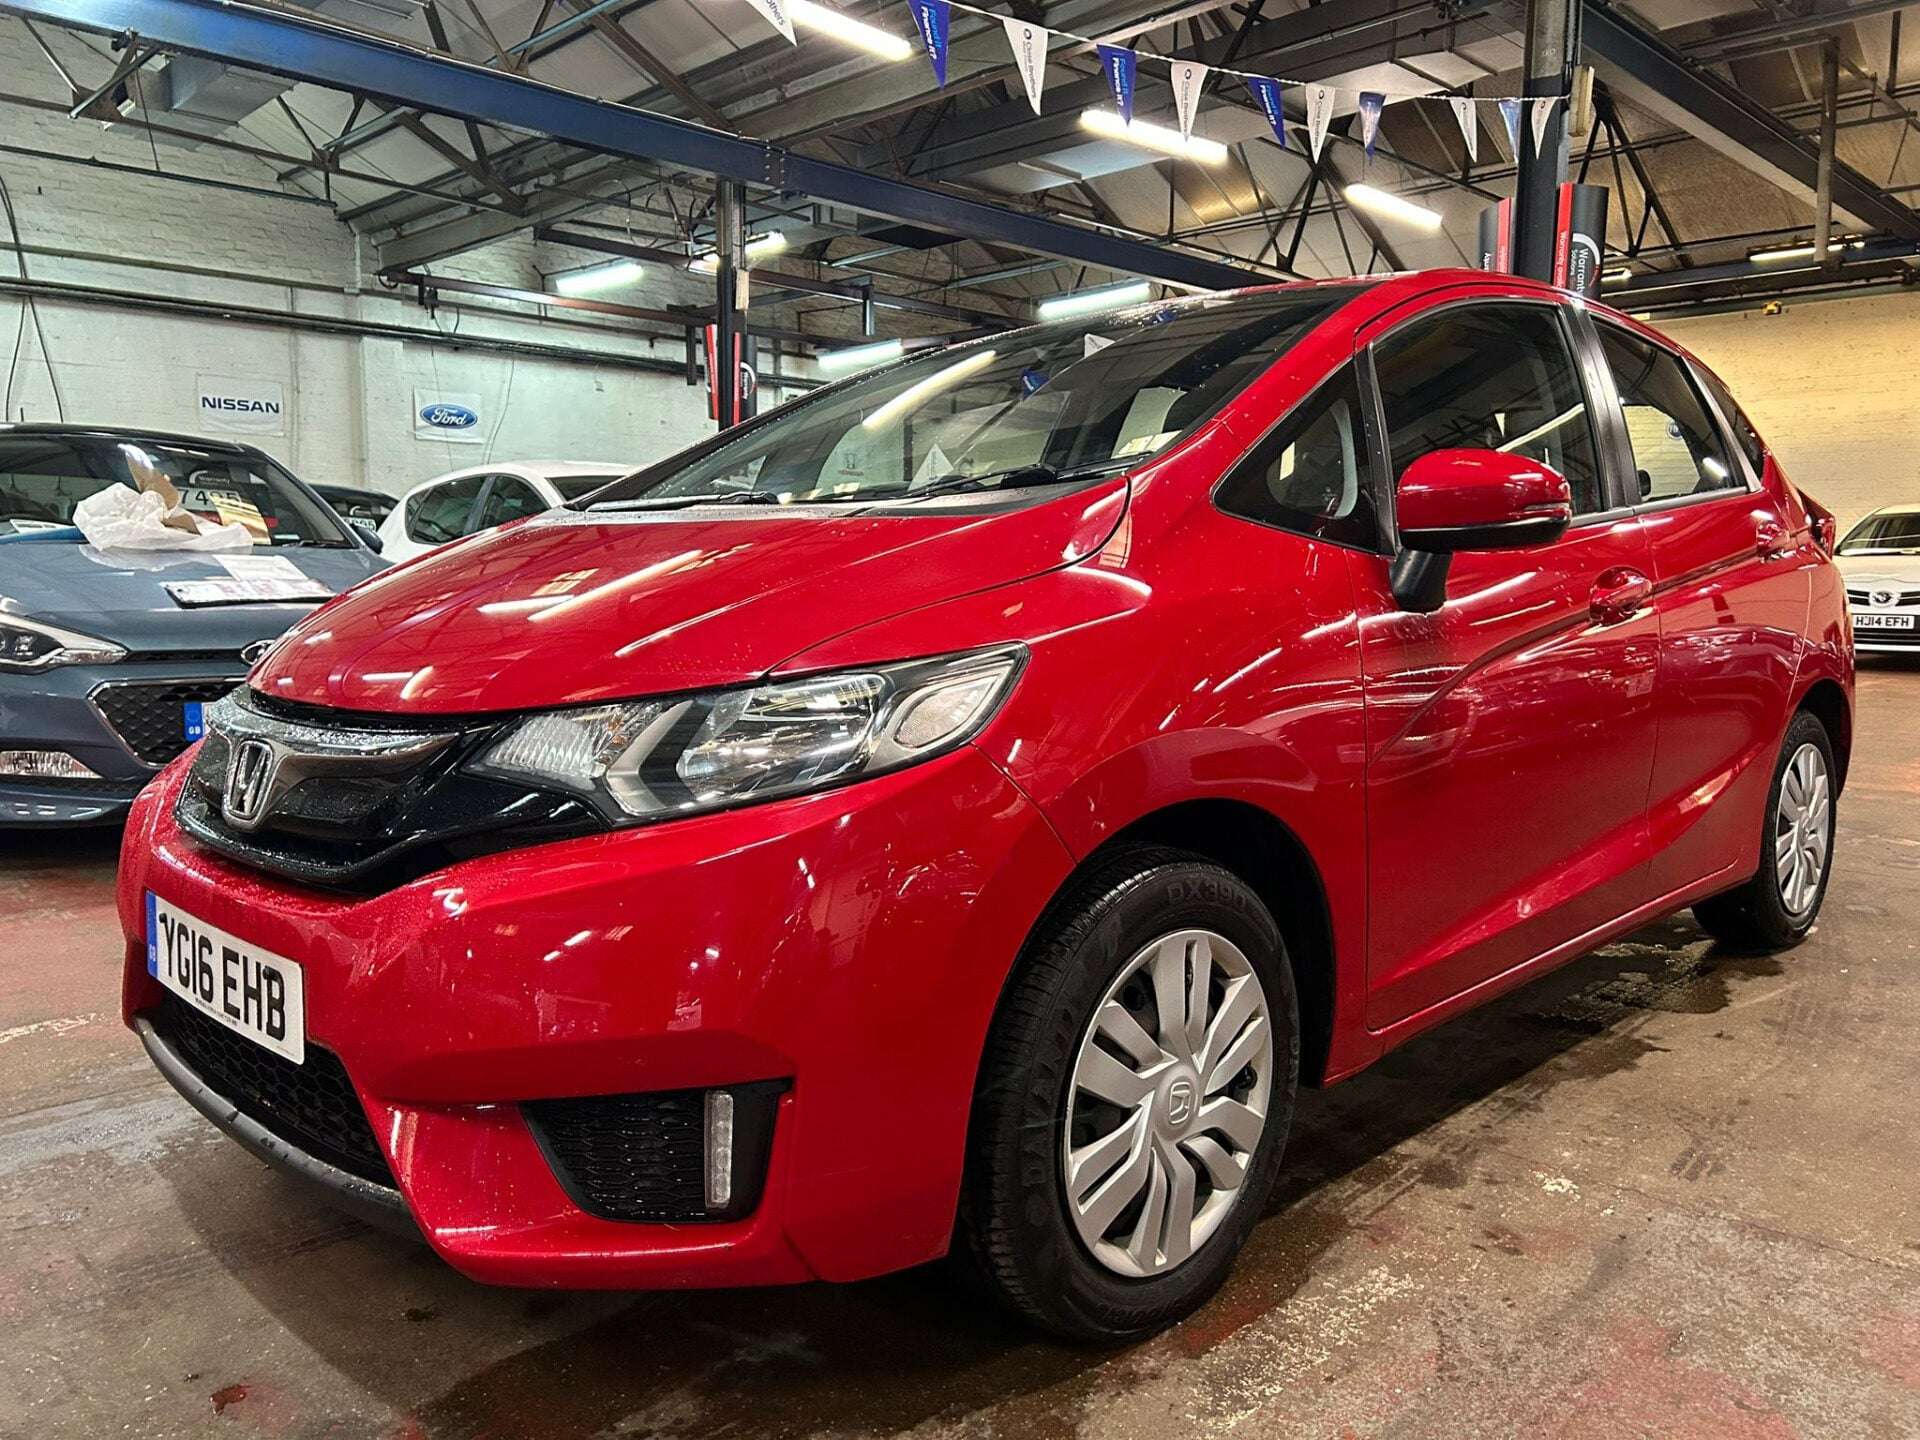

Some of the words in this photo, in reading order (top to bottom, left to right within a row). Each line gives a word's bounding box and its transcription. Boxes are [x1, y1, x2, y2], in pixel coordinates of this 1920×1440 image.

[920, 6, 934, 46] Finance
[927, 45, 937, 60] It?
[1556, 231, 1568, 266] Warranty
[202, 396, 280, 414] NISSAN
[429, 408, 467, 426] Ford
[1855, 616, 1882, 626] HJ14
[1885, 616, 1909, 627] EFH
[188, 726, 201, 735] GB
[159, 913, 214, 1004] YG16
[222, 945, 285, 1042] EHB
